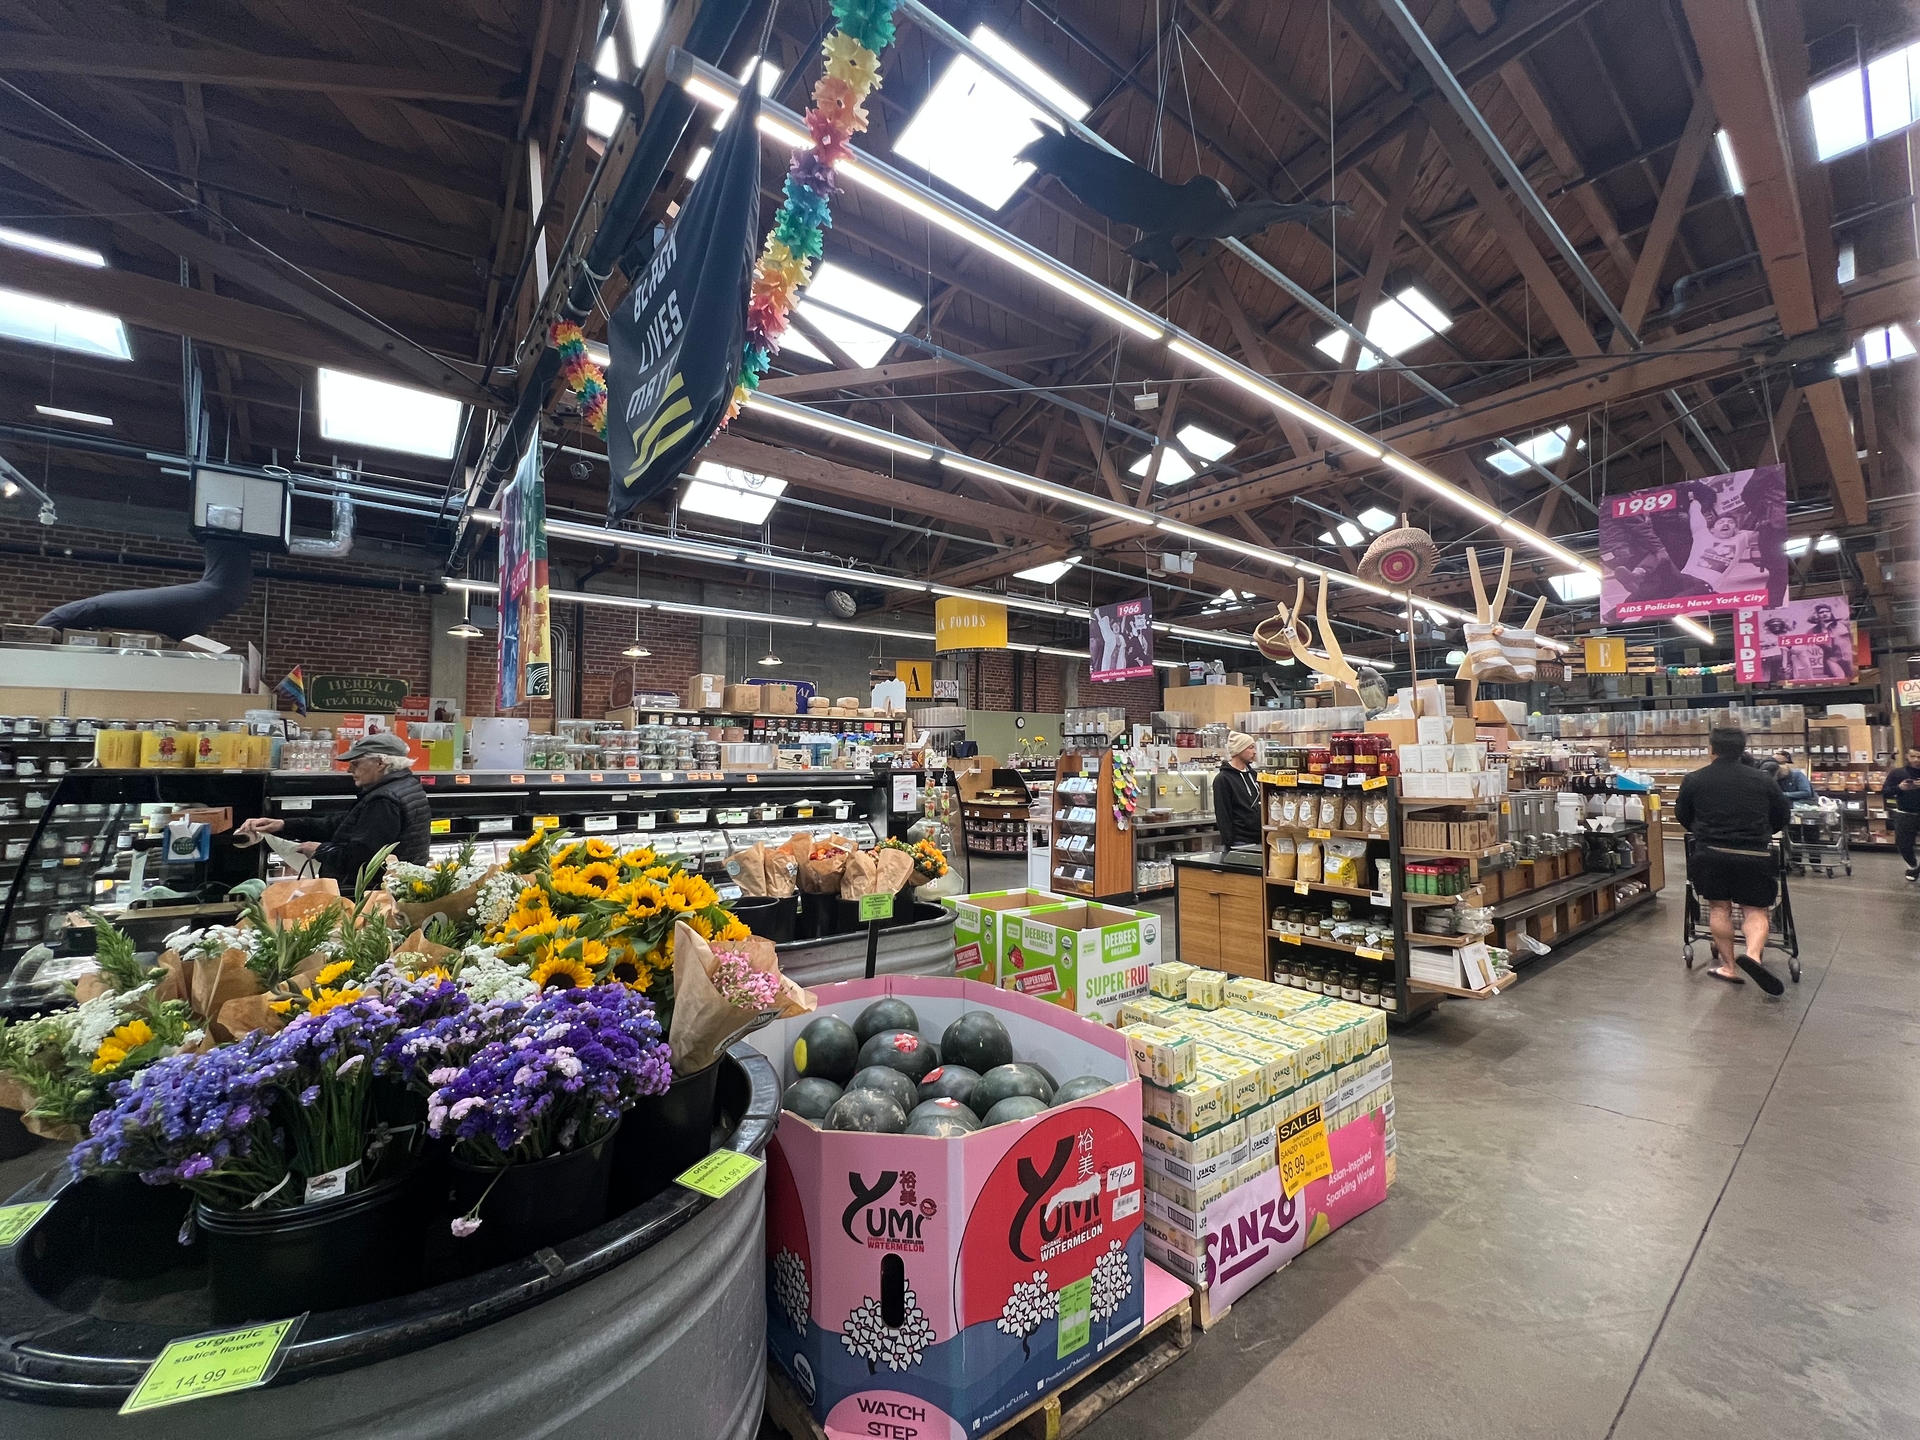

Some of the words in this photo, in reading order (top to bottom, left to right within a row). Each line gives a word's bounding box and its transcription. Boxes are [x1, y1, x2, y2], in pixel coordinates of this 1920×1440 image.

[638, 289, 684, 375] LIVES
[626, 350, 679, 423] MATT
[1618, 493, 1673, 516] 1989
[1119, 604, 1140, 616] 1966
[1619, 605, 1642, 614] AIDS
[1644, 601, 1684, 612] Policies,
[1687, 599, 1713, 607] New
[1716, 595, 1741, 605] York
[1743, 593, 1766, 603] City
[950, 614, 986, 629] FOODS
[1738, 611, 1756, 673] PRIDE
[1781, 637, 1791, 645] is
[1794, 637, 1803, 645] a
[1806, 633, 1830, 644] riot
[1600, 643, 1611, 667] E
[328, 679, 393, 693] HERBAL
[908, 666, 921, 691] A
[1903, 682, 1920, 691] OA
[323, 697, 346, 707] TEA
[352, 697, 400, 709] BLENDS
[1086, 963, 1153, 999] SUPERFRUI
[1096, 994, 1118, 1006] ORGANIC
[1118, 990, 1136, 1001] FREEZIE
[1136, 985, 1148, 995] POPS
[1226, 991, 1248, 1004] SANZO
[1124, 1012, 1143, 1023] SANZO
[1305, 1051, 1322, 1066] SANZO
[1272, 1066, 1291, 1082] SANZO
[1236, 1082, 1256, 1099] SANZO
[1195, 1100, 1217, 1118] SANZO
[1280, 1108, 1320, 1139] SALE!
[1077, 1127, 1094, 1180] 裕美
[1252, 1136, 1270, 1152] SANZO
[1281, 1144, 1298, 1160] SANZO
[1299, 1136, 1312, 1149] YUZU
[1312, 1130, 1324, 1142] 6PK
[693, 1156, 720, 1175] organic
[1110, 1166, 1133, 1182] 45/50
[1197, 1163, 1217, 1180] SANZO
[1283, 1154, 1305, 1182] $6.99
[1328, 1147, 1372, 1186] Asian-inspired
[719, 1168, 741, 1184] 14.99
[1326, 1179, 1357, 1207] Sparkling
[1356, 1165, 1376, 1185] Water
[1200, 1191, 1221, 1211] SANZO
[867, 1241, 925, 1253] WATERMELON
[1040, 1224, 1103, 1262] WATERMELON
[1040, 1237, 1062, 1250] ORGANIC
[1205, 1192, 1299, 1289] SANZO
[195, 1329, 263, 1349] organic
[173, 1348, 218, 1365] statice
[219, 1340, 266, 1355] flowers
[175, 1368, 227, 1390] 14.99
[231, 1364, 262, 1376] EACH
[1045, 1368, 1066, 1384] Product
[1066, 1361, 1073, 1371] of
[1073, 1352, 1091, 1366] Mexico
[857, 1397, 926, 1422] WATCH
[982, 1404, 1005, 1423] Product
[1006, 1399, 1013, 1408] of
[1013, 1390, 1030, 1404] USA
[867, 1421, 918, 1440] STEP
